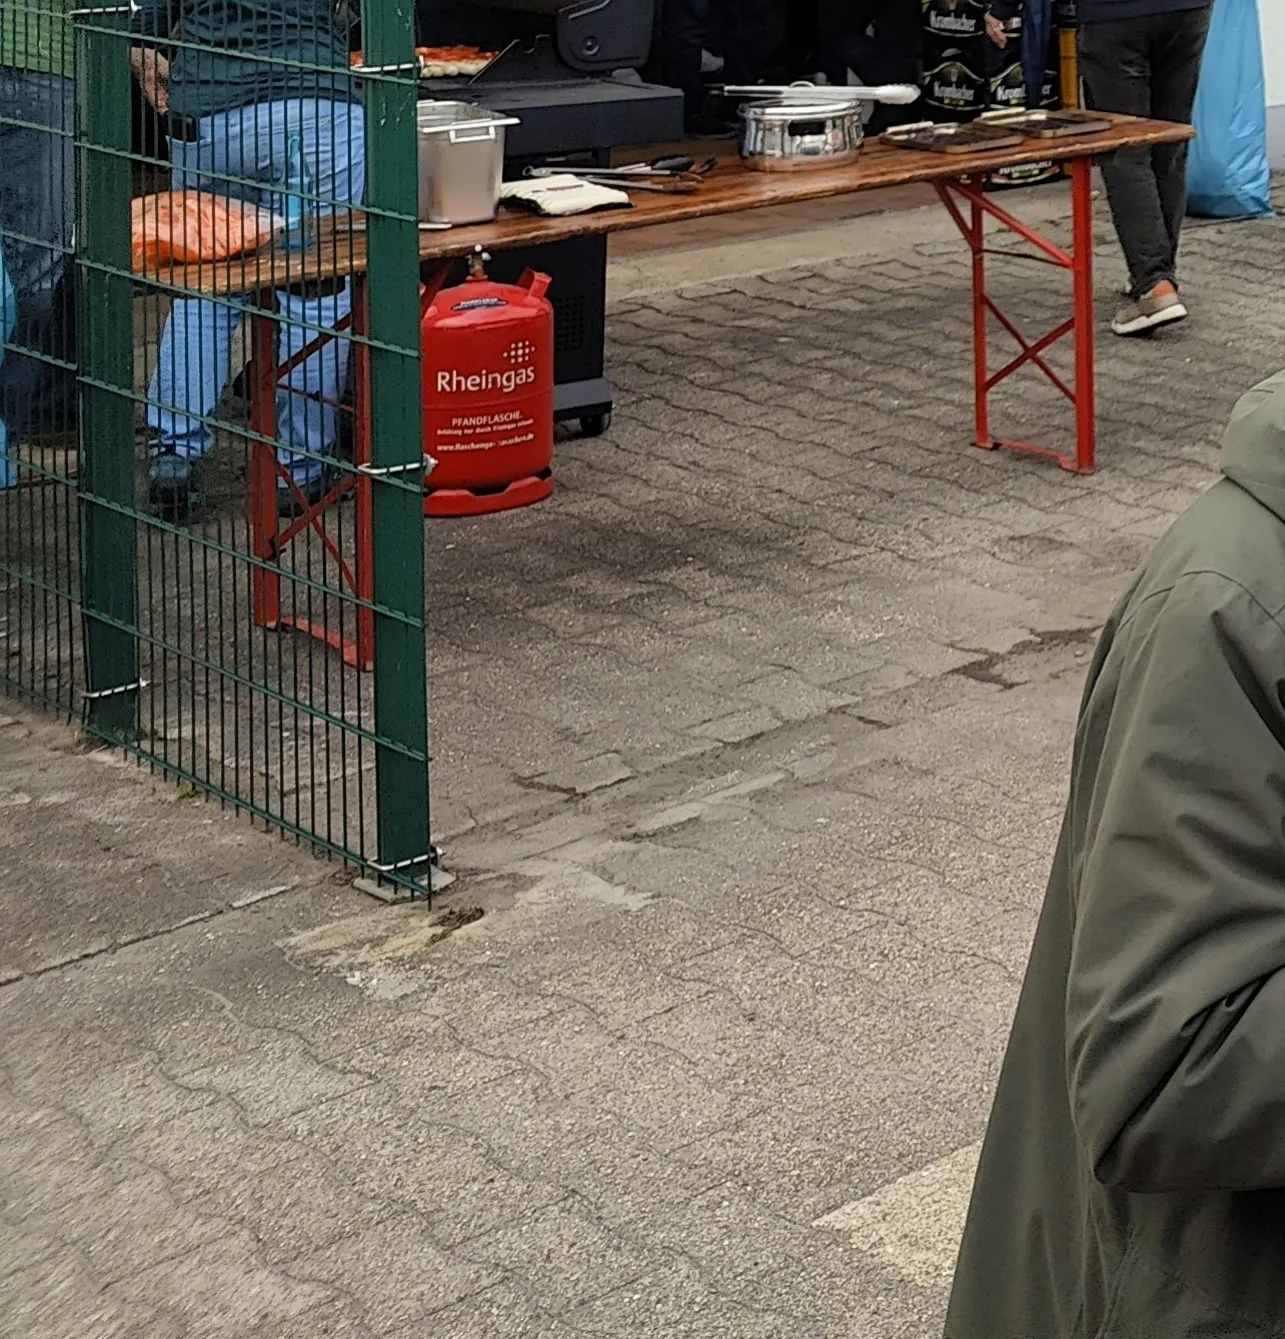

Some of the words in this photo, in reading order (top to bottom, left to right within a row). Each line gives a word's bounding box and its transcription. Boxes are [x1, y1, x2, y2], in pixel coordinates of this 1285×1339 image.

[930, 11, 976, 32] Krombacher
[934, 81, 975, 101] Krombacher
[437, 366, 535, 392] Rheingas
[452, 410, 523, 426] PFANDFLASCHE.
